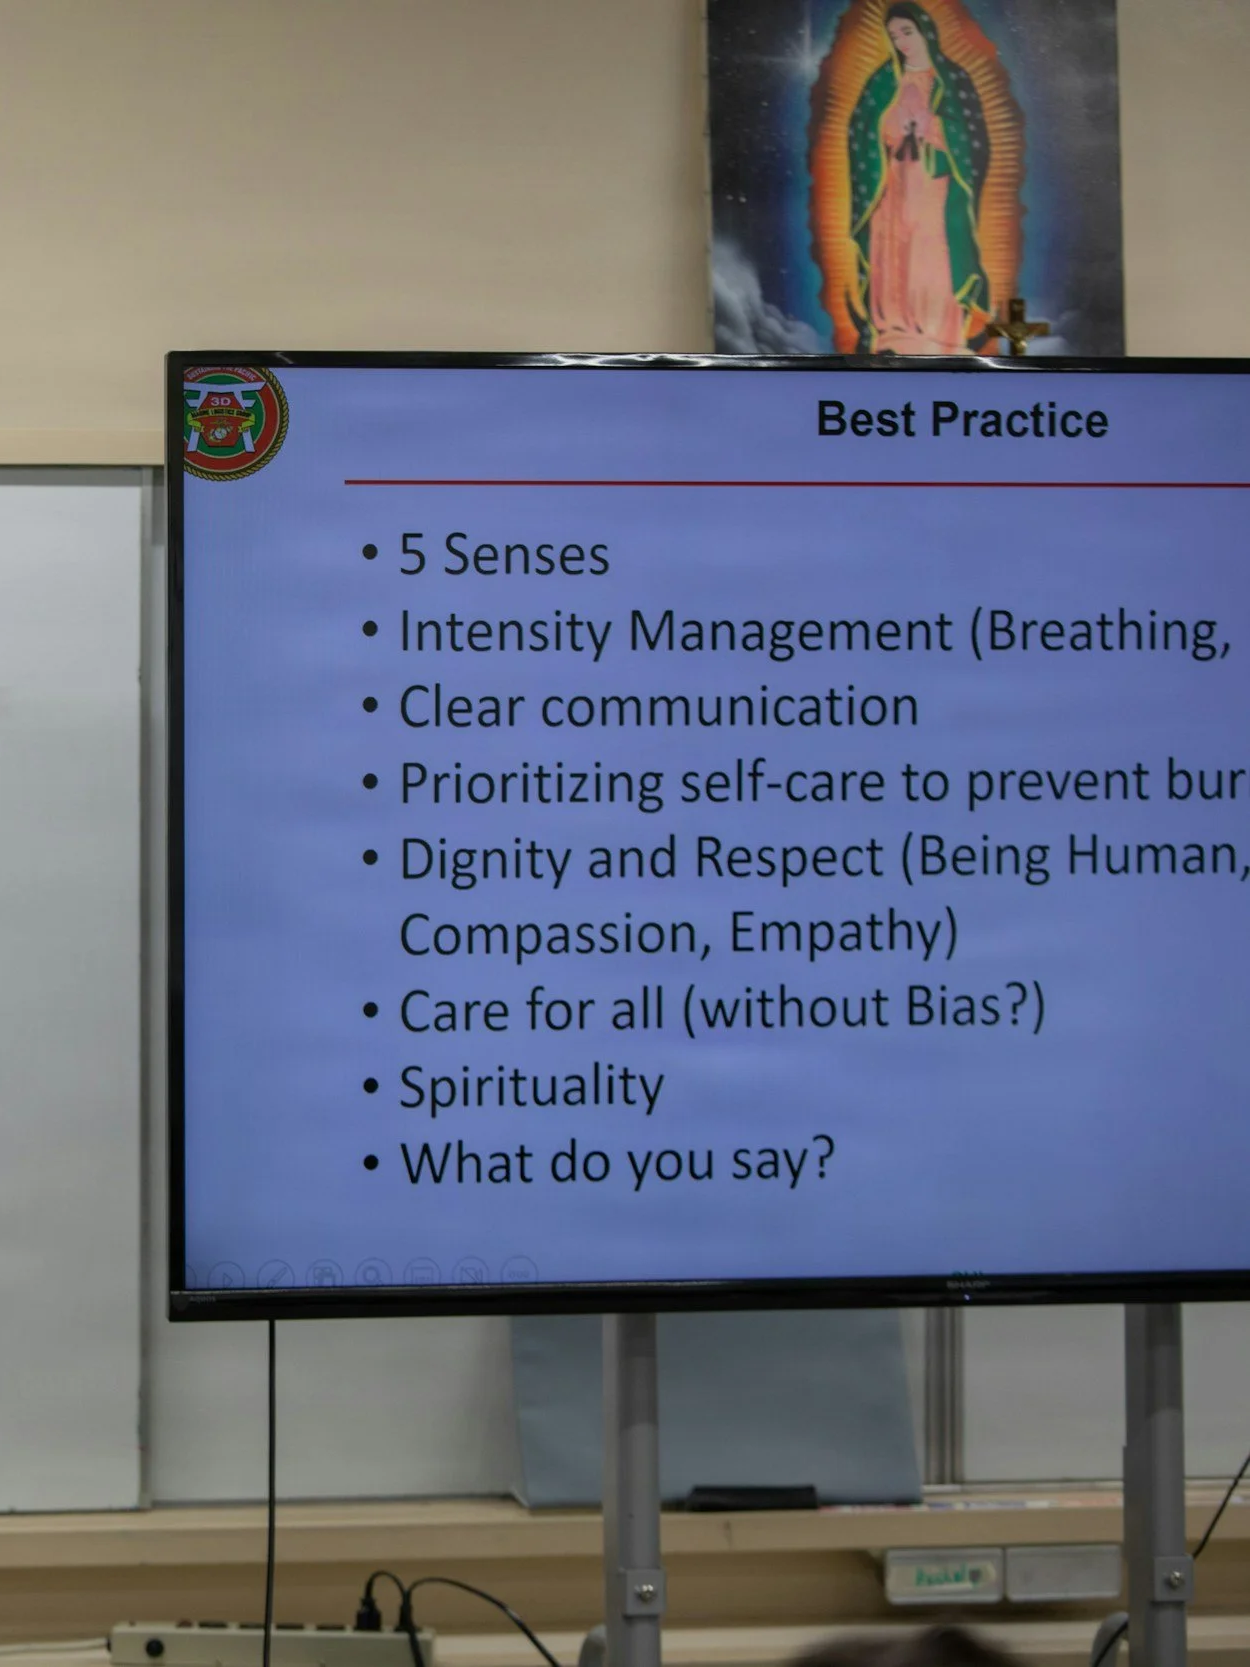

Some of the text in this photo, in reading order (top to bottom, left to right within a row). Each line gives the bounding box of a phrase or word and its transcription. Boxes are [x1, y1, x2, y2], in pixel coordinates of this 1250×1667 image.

[210, 396, 232, 407] 3D
[818, 400, 1109, 439] Best Practice
[400, 531, 610, 576] 5 Senses
[402, 605, 1231, 663] Intensity Management (Breathing,
[400, 682, 918, 728] Clear communication
[402, 756, 1250, 814] Prioritizing self-care to prevent bur
[402, 831, 1250, 891] Dignity and Respect (Being Human,
[400, 905, 957, 966] Compassion, Empathy)
[400, 980, 1045, 1040] Care for all (without Bias?)
[400, 1061, 665, 1119] Spirituality
[400, 1133, 835, 1192] What do you say?
